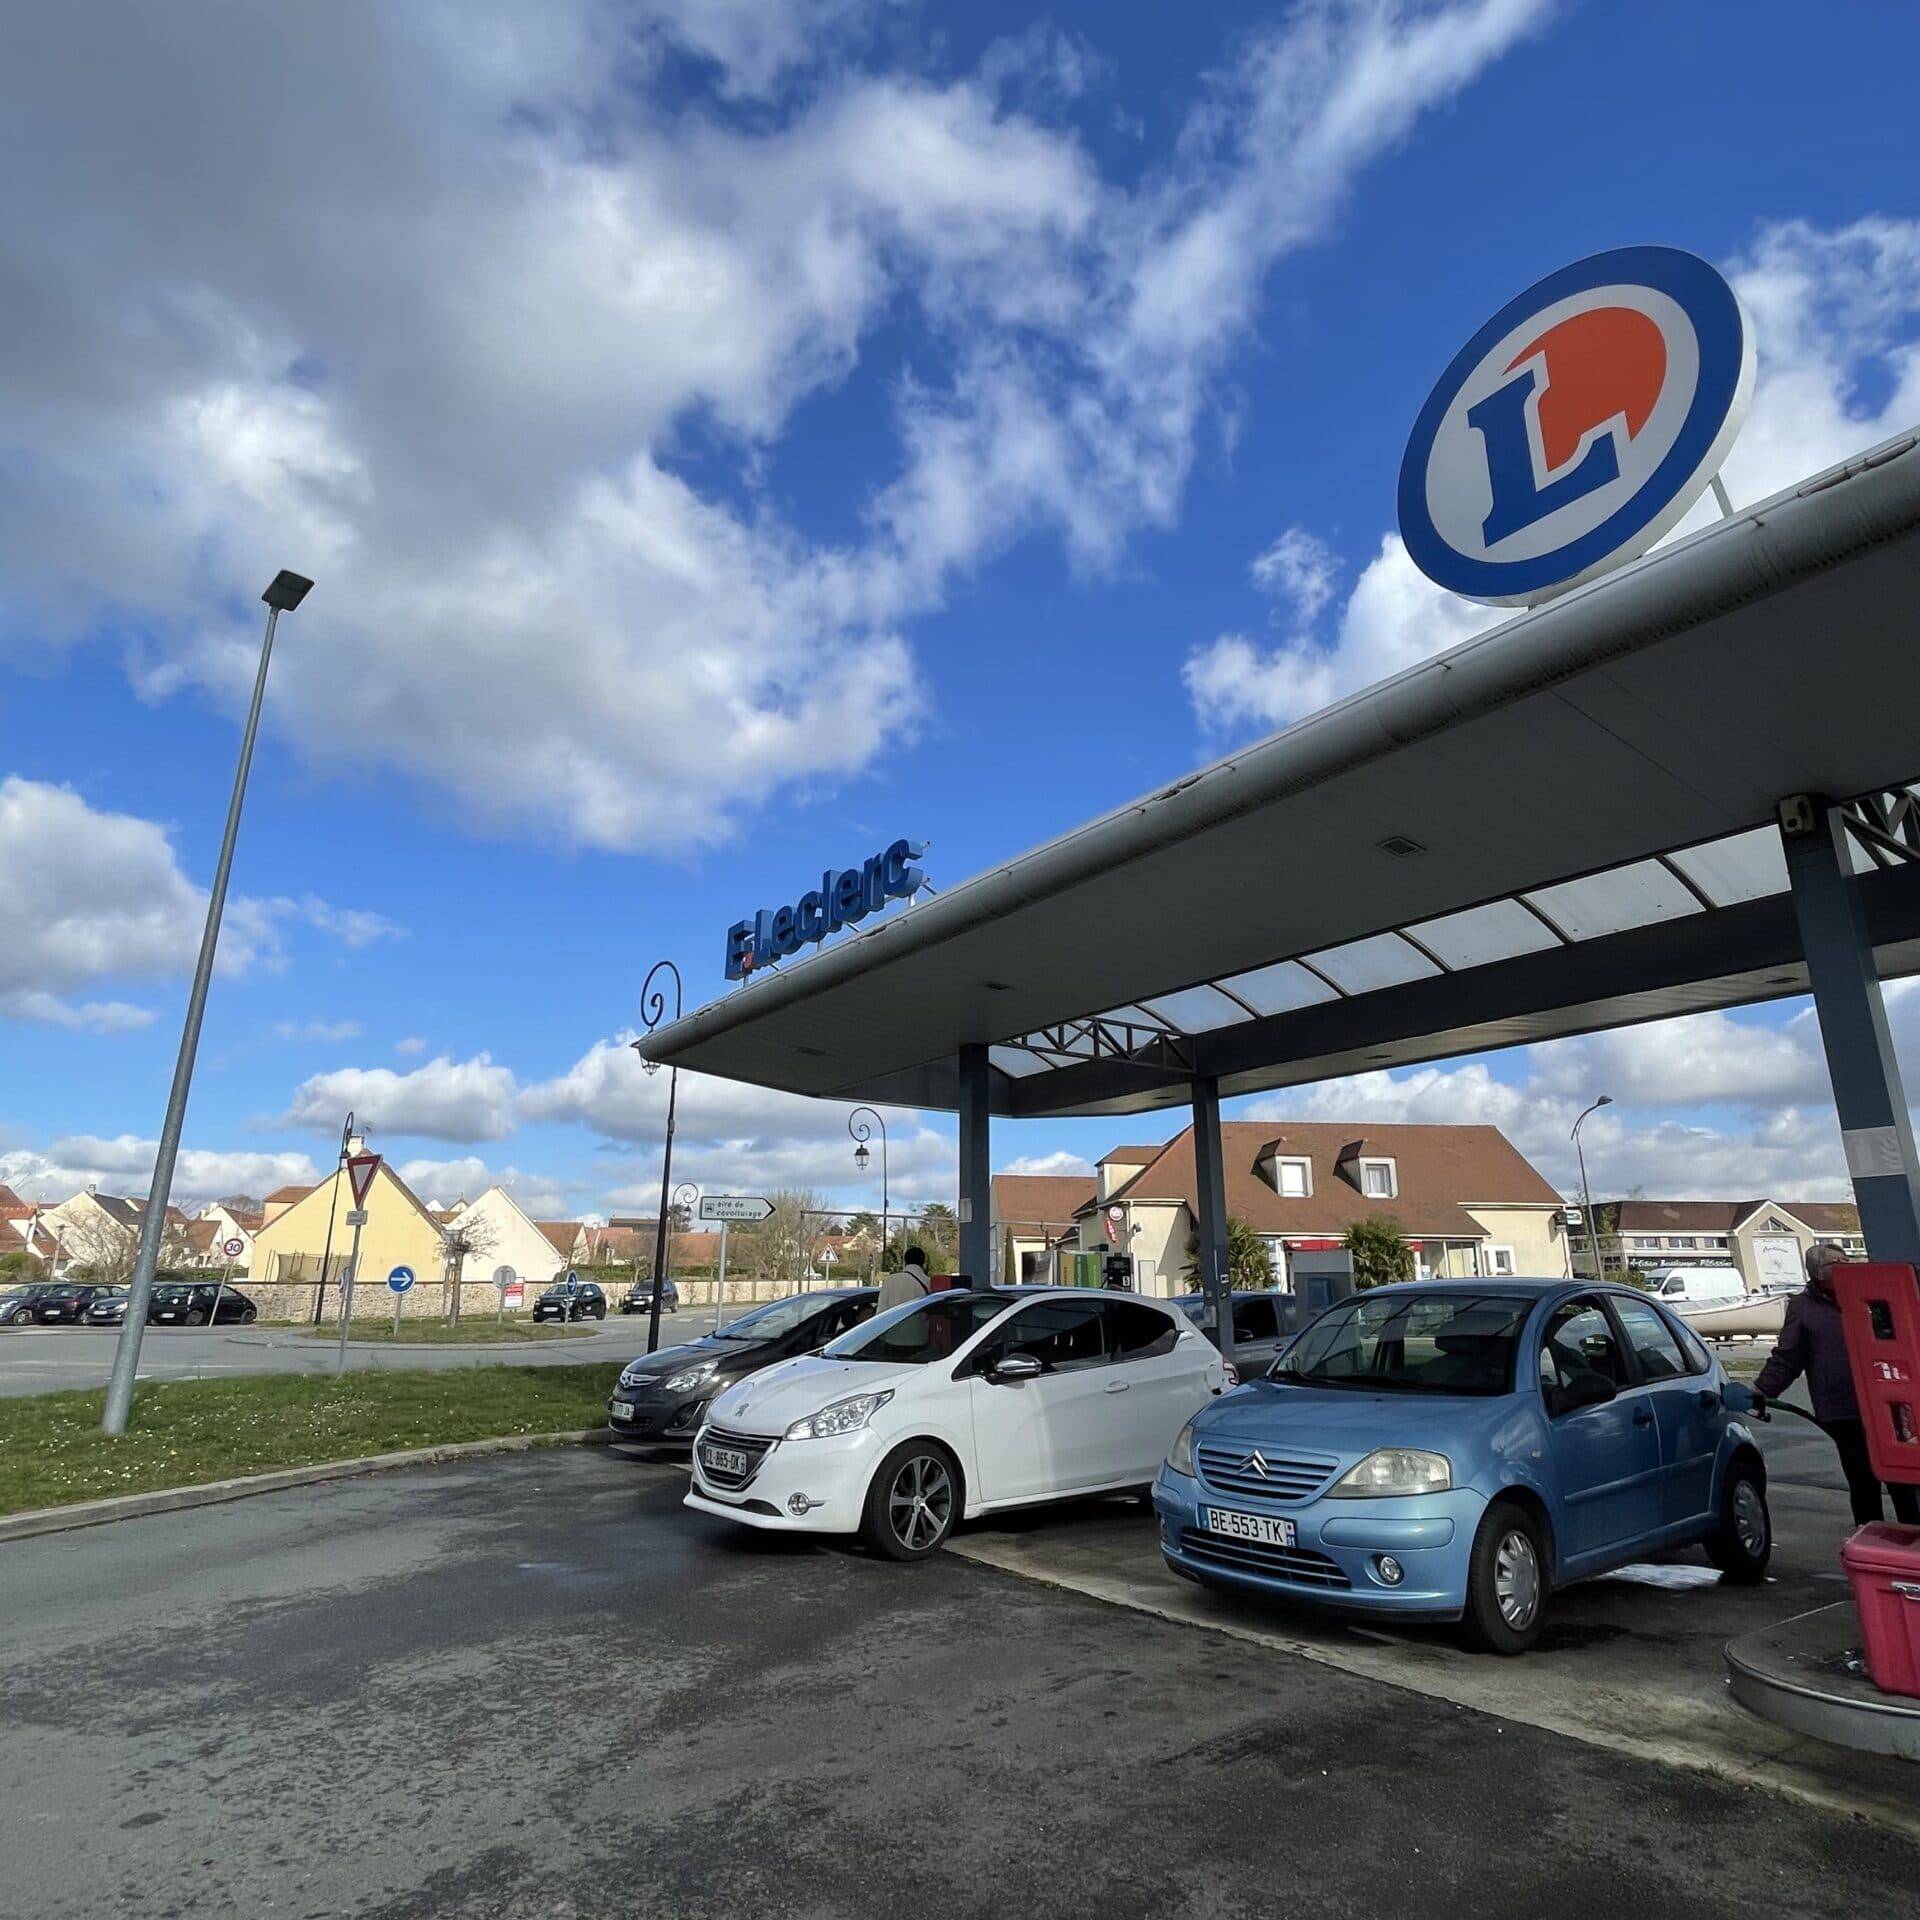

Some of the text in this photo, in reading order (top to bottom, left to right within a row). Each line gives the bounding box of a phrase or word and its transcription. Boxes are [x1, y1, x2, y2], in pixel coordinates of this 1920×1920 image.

[1467, 368, 1621, 549] L
[735, 1200, 744, 1208] de
[716, 1209, 762, 1218] covoiturage
[228, 1242, 240, 1252] 30
[1210, 1510, 1284, 1543] BE-553-TK
